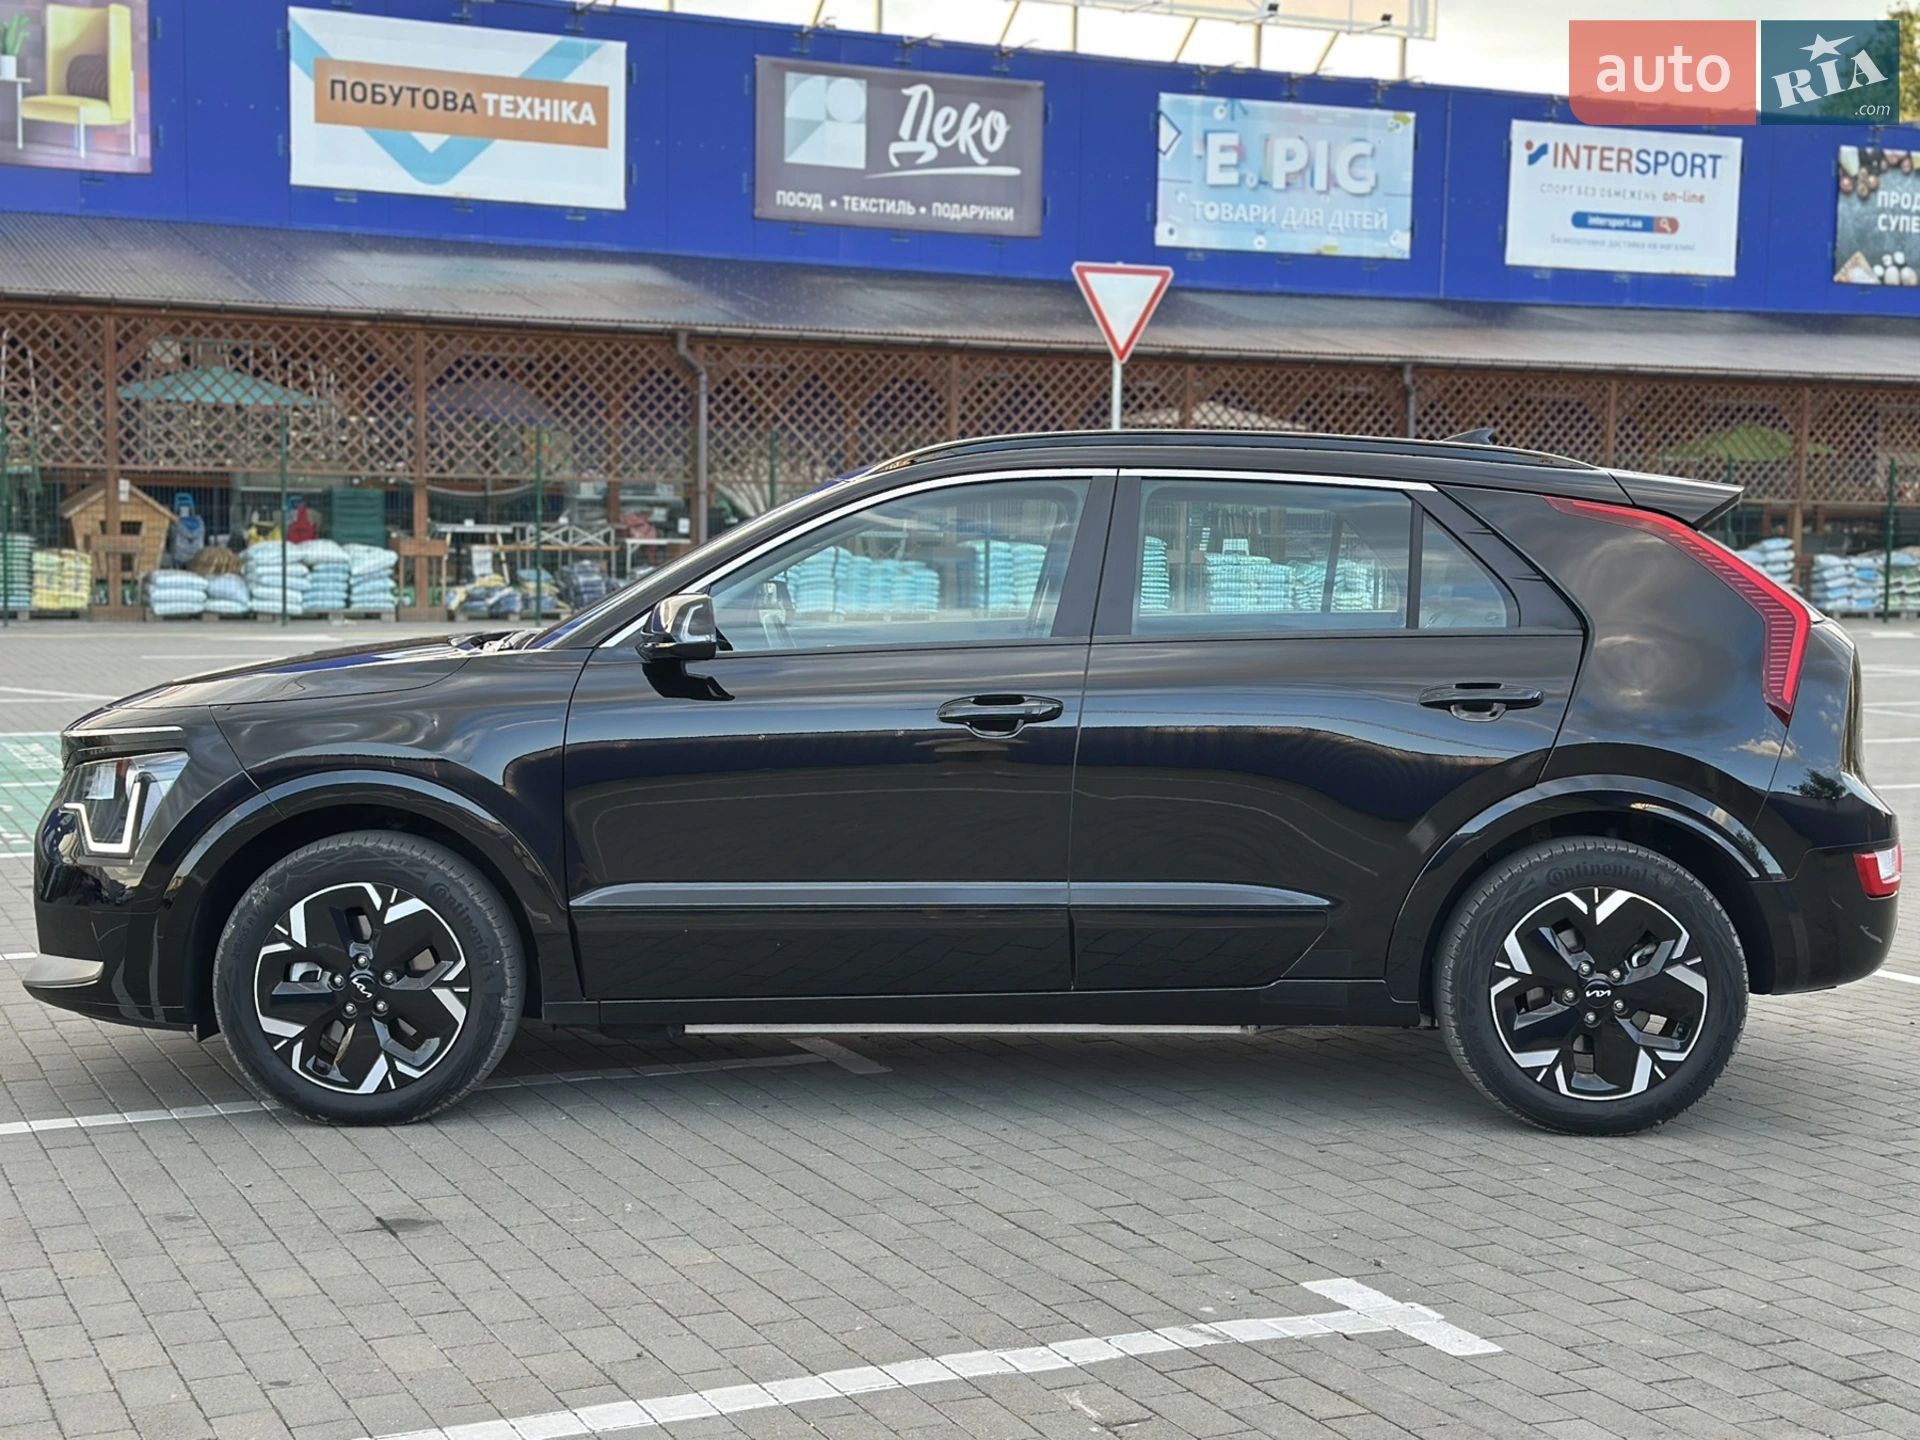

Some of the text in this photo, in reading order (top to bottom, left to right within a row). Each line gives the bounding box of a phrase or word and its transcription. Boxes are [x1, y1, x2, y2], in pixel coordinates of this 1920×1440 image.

[330, 79, 597, 126] ПОБУТОВА ТЕХНІКА
[888, 83, 1011, 168] Деко
[1552, 141, 1723, 180] INTERSPORT
[776, 190, 1015, 222] ПОСУД ТЕКСТИЛЬ ПОДАРУНКИ
[1540, 182, 1574, 196] СПОРТ
[1577, 185, 1597, 197] БЕЗ
[1662, 189, 1706, 203] on-line
[1192, 200, 1389, 233] ТОВАРИ ДЛЯ ДІТЕЙ
[1587, 214, 1644, 230] intersport.ua
[1545, 860, 1648, 885] Continental
